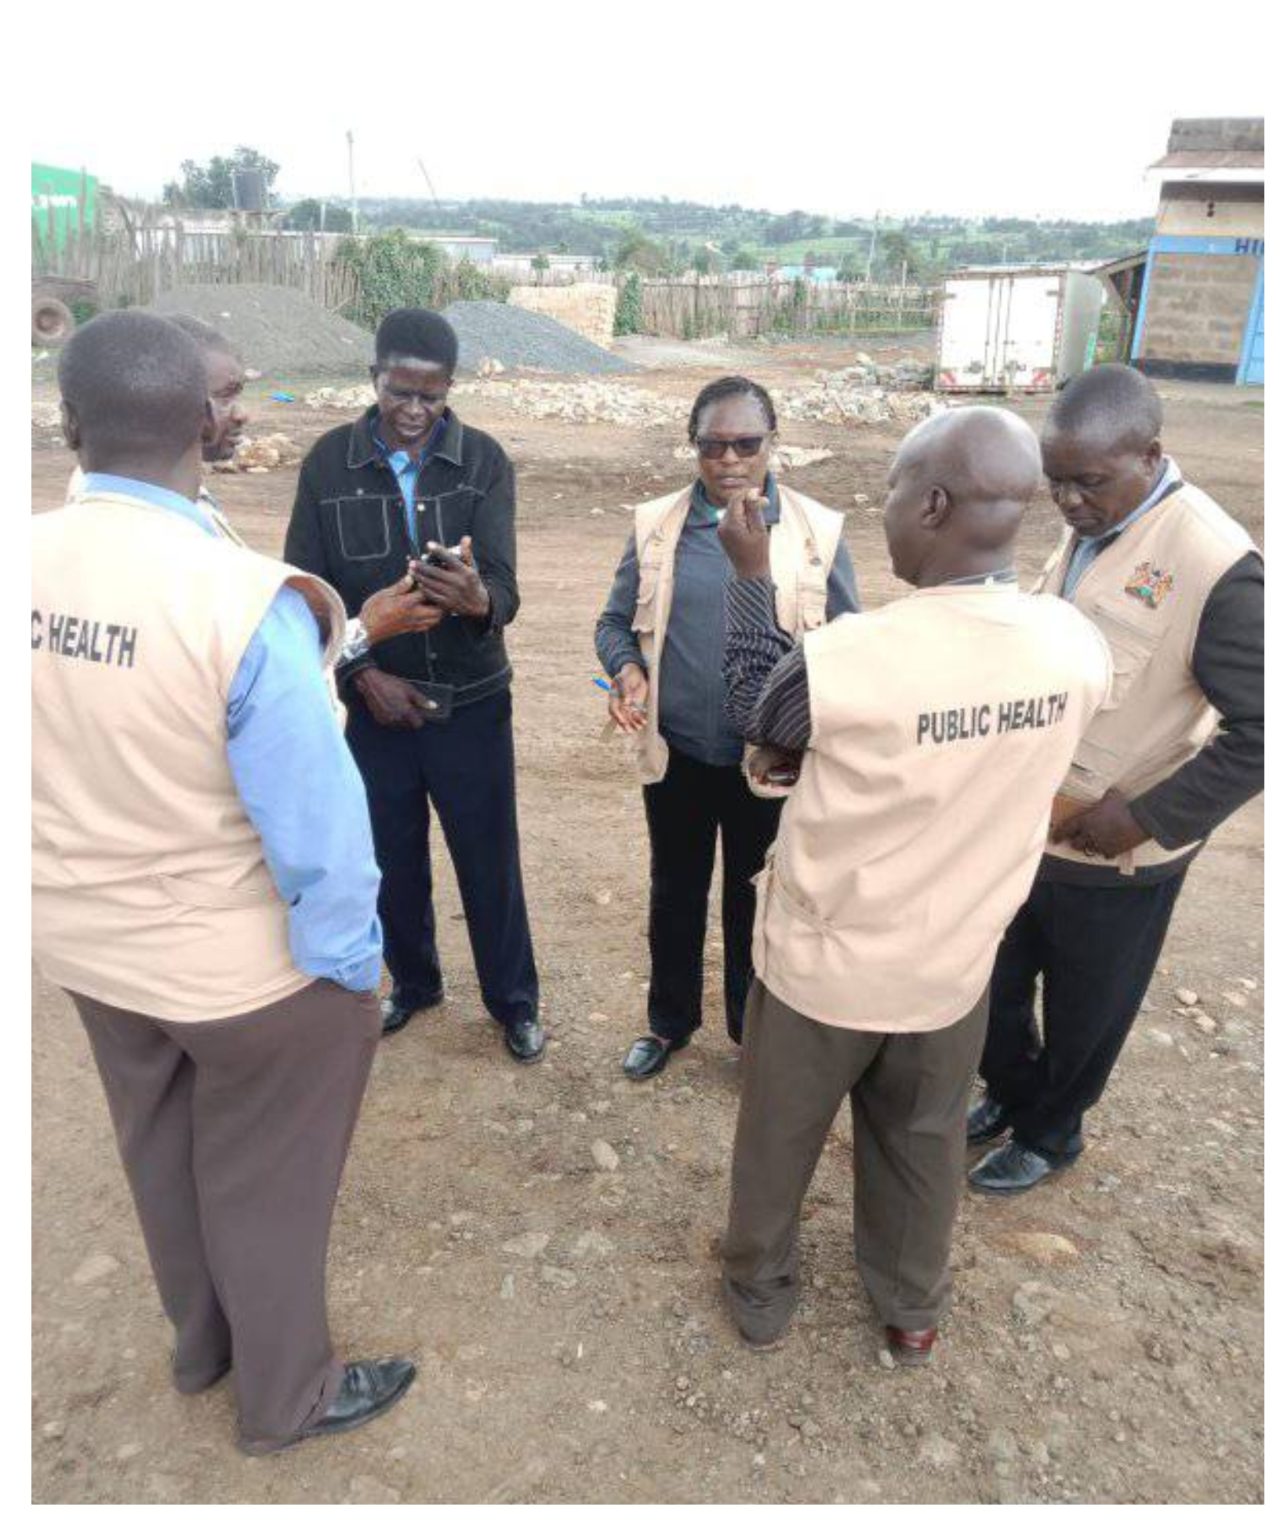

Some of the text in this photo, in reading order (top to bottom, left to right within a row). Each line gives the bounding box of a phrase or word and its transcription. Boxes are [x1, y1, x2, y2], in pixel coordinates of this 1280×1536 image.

[49, 612, 138, 669] HEALTH
[916, 691, 1069, 746] PUBLIC HEALTH
